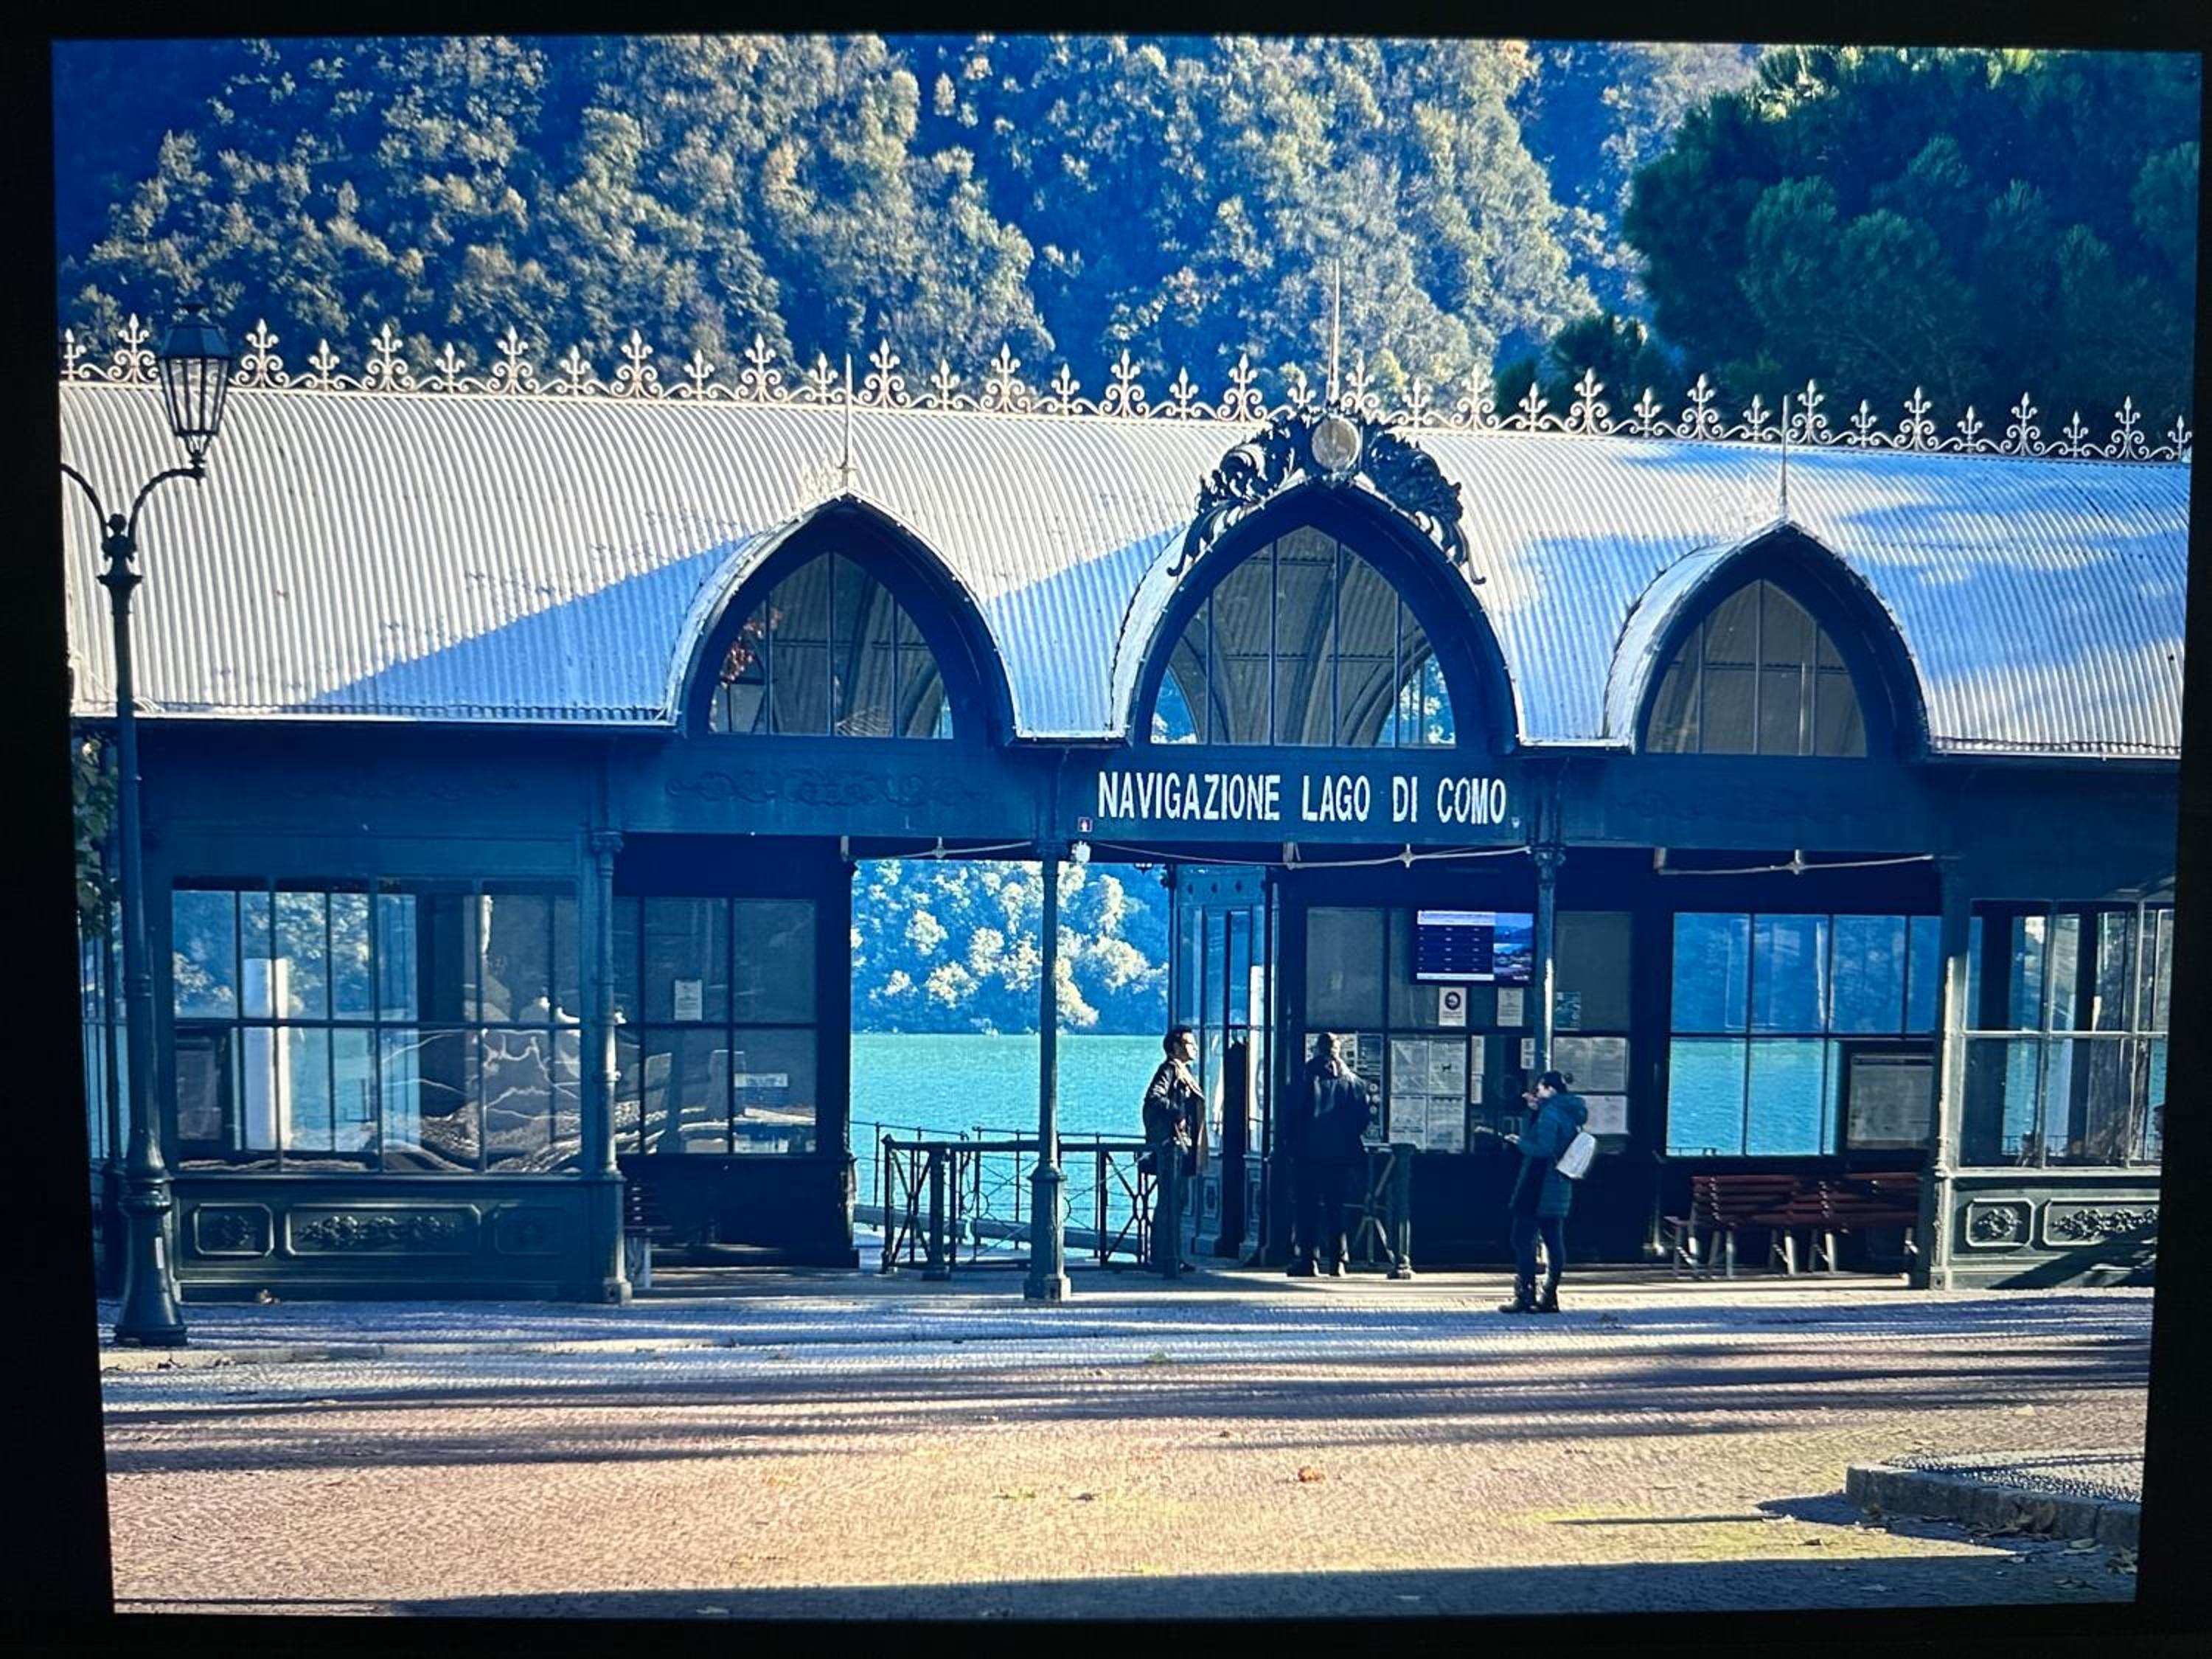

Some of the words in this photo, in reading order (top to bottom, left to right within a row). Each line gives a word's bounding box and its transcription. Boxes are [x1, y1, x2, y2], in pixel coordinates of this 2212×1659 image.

[1099, 772, 1280, 820] NAVIGAZIONE
[1303, 776, 1370, 821] LAGO
[1394, 777, 1417, 821] DI
[1438, 778, 1506, 824] COMO
